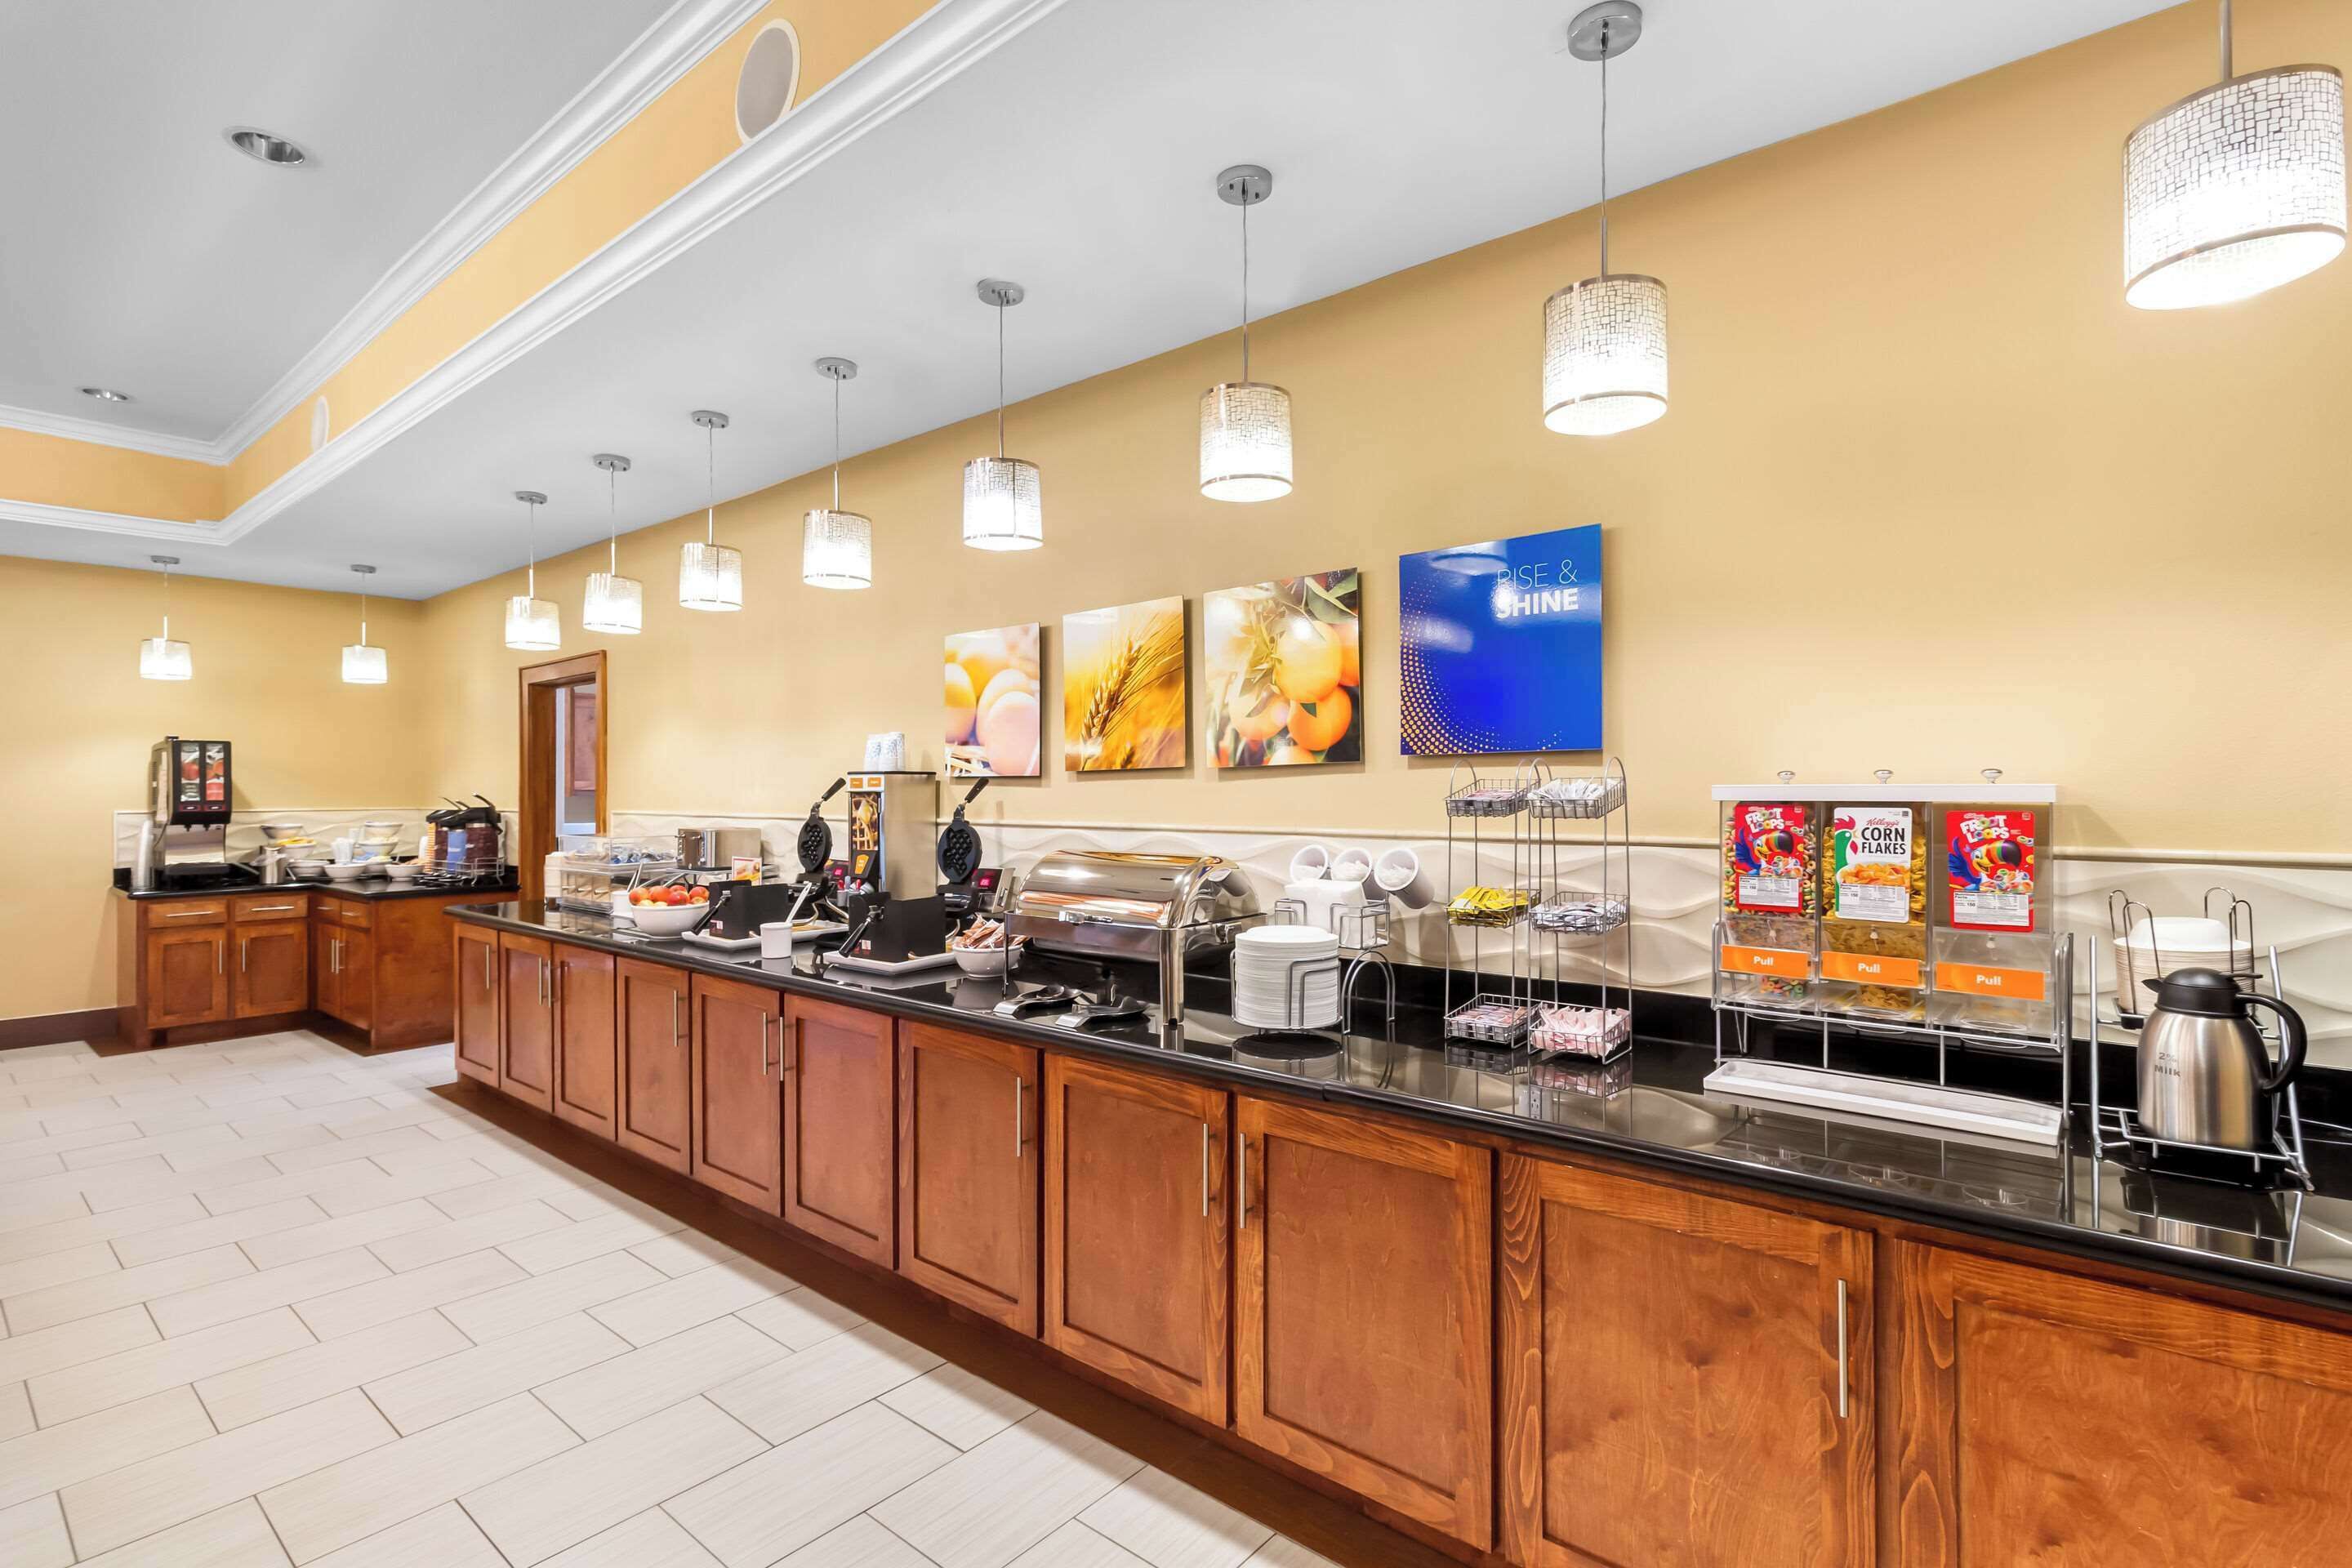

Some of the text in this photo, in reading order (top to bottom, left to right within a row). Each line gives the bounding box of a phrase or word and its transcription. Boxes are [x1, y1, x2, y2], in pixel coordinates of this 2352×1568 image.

[1497, 559, 1578, 590] RISE &
[1744, 808, 1784, 826] FROOT
[1865, 817, 1900, 828] Kellogg's
[1749, 818, 1785, 834] LOOPS
[1959, 815, 2007, 835] FROOT
[1861, 826, 1905, 842] CORN
[1966, 826, 2010, 844] LOOPS
[1861, 842, 1907, 855] FLAKES
[1753, 956, 1774, 966] Pull
[1858, 963, 1881, 973] Pull
[1976, 974, 2002, 987] Pull
[2158, 1052, 2177, 1062] 2%
[2154, 1064, 2181, 1077] Milk
